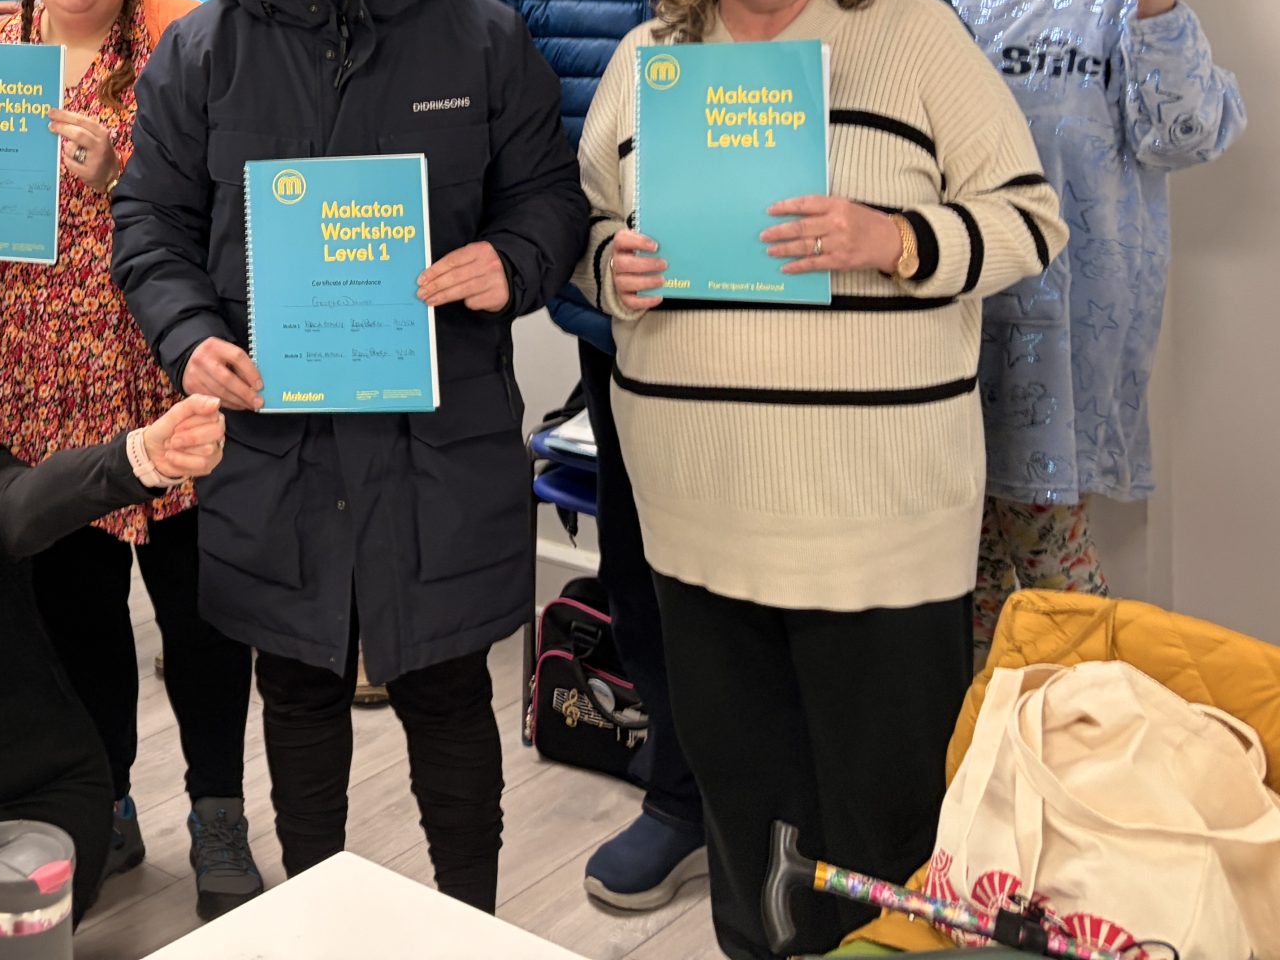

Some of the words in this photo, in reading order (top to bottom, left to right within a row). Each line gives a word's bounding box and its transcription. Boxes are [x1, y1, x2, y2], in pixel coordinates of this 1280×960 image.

[706, 86, 793, 104] Makaton
[412, 96, 471, 113] DIDRIKSONS
[19, 118, 28, 132] 1
[705, 107, 806, 132] Workshop
[707, 130, 760, 148] Level
[765, 128, 776, 148] 1
[321, 201, 404, 218] Makaton
[321, 222, 416, 244] Workshop
[324, 244, 374, 262] Level
[380, 243, 390, 261] 1
[282, 392, 324, 401] Makaton
